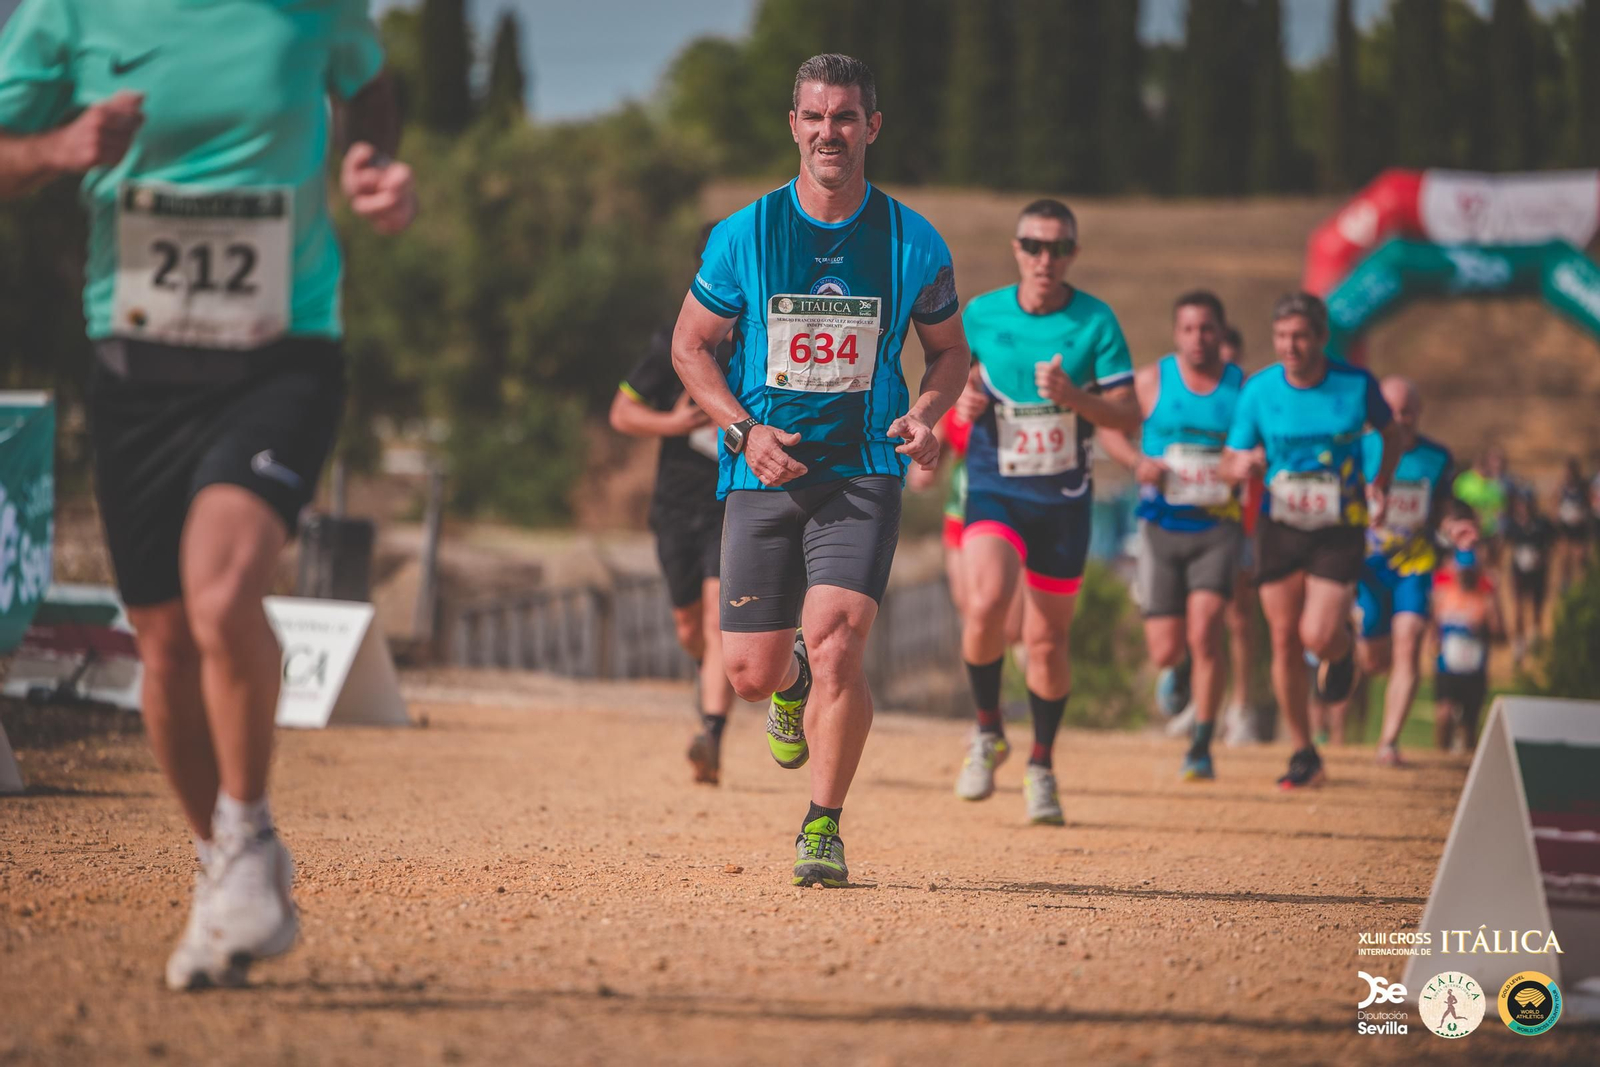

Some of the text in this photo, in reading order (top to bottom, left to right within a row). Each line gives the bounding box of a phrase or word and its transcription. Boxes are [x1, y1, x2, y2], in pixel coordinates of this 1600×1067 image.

[151, 239, 260, 296] 212
[800, 298, 851, 313] ITÁLICA
[790, 332, 859, 365] 634
[1014, 427, 1065, 454] 219
